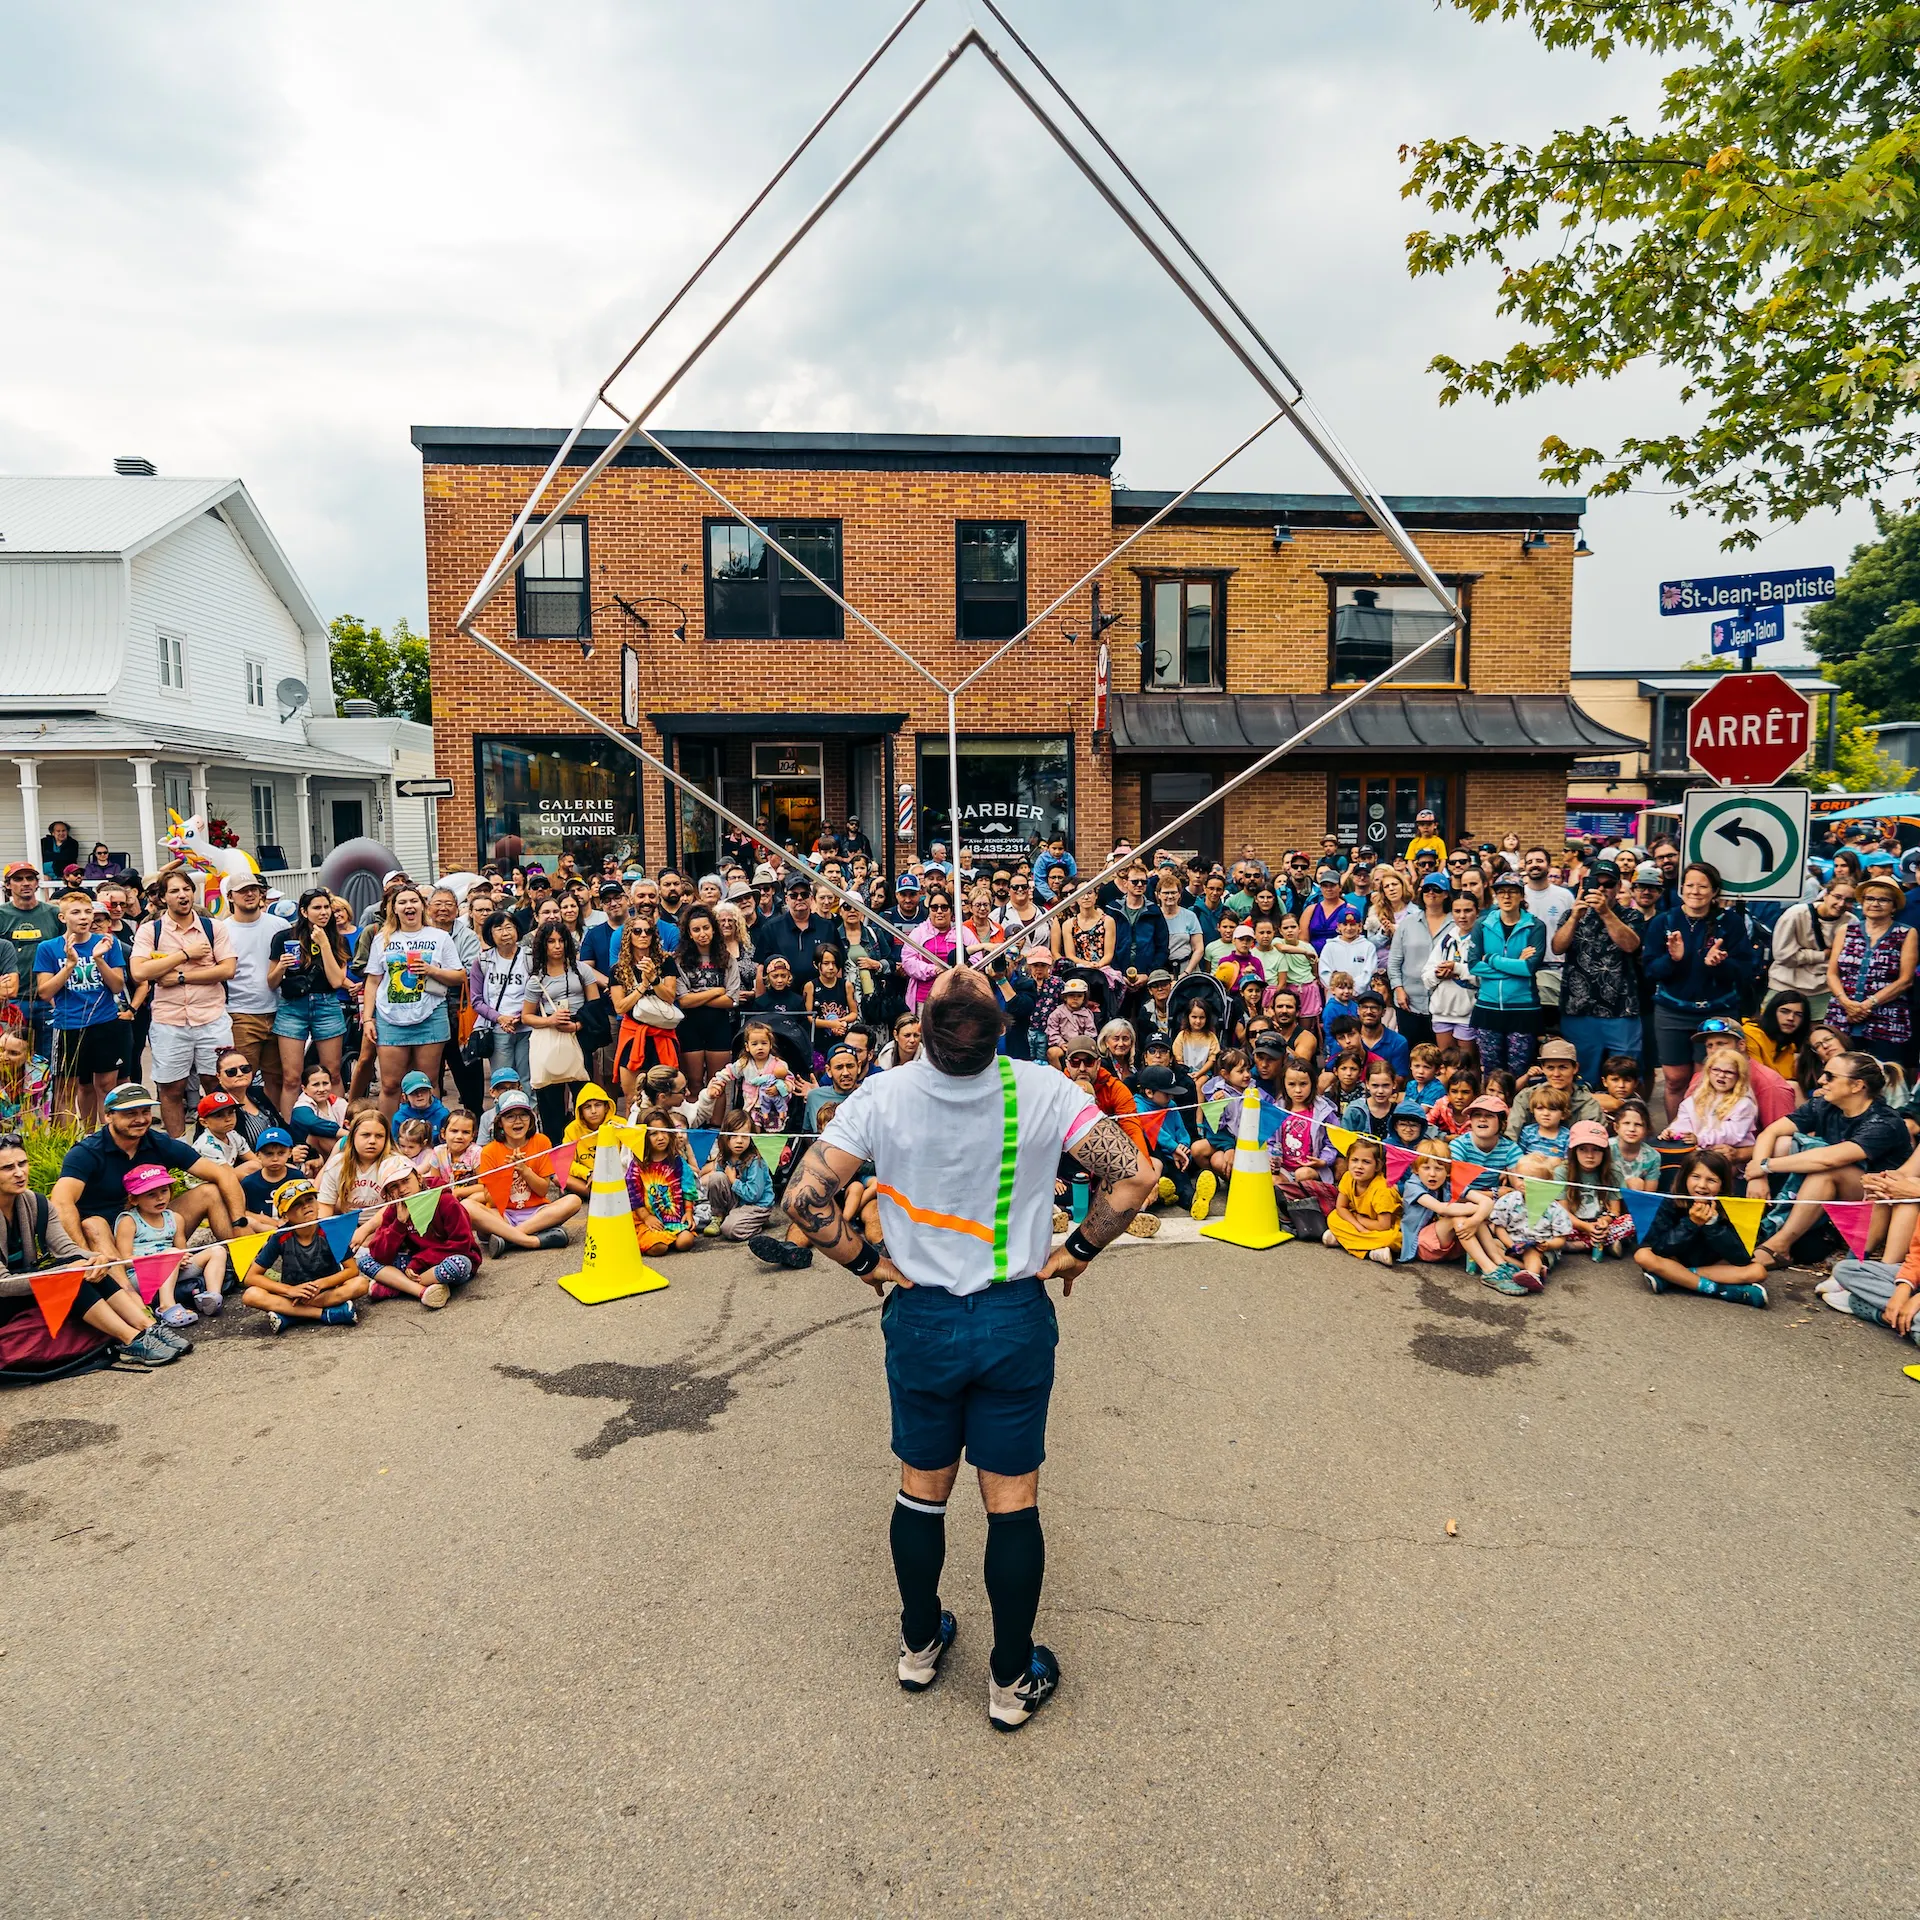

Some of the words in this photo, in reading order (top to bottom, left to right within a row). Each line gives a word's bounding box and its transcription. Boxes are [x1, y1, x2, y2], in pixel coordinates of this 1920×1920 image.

[1681, 577, 1835, 608] St-Jean-Baptiste
[1730, 620, 1777, 646] Jean-Talon
[1694, 707, 1804, 748] ARRÊT
[780, 761, 795, 771] 104
[539, 799, 614, 810] GALERIE
[540, 813, 614, 823] GUYLAINE
[948, 803, 1044, 821] BARBIER
[541, 826, 616, 836] FOURNIER
